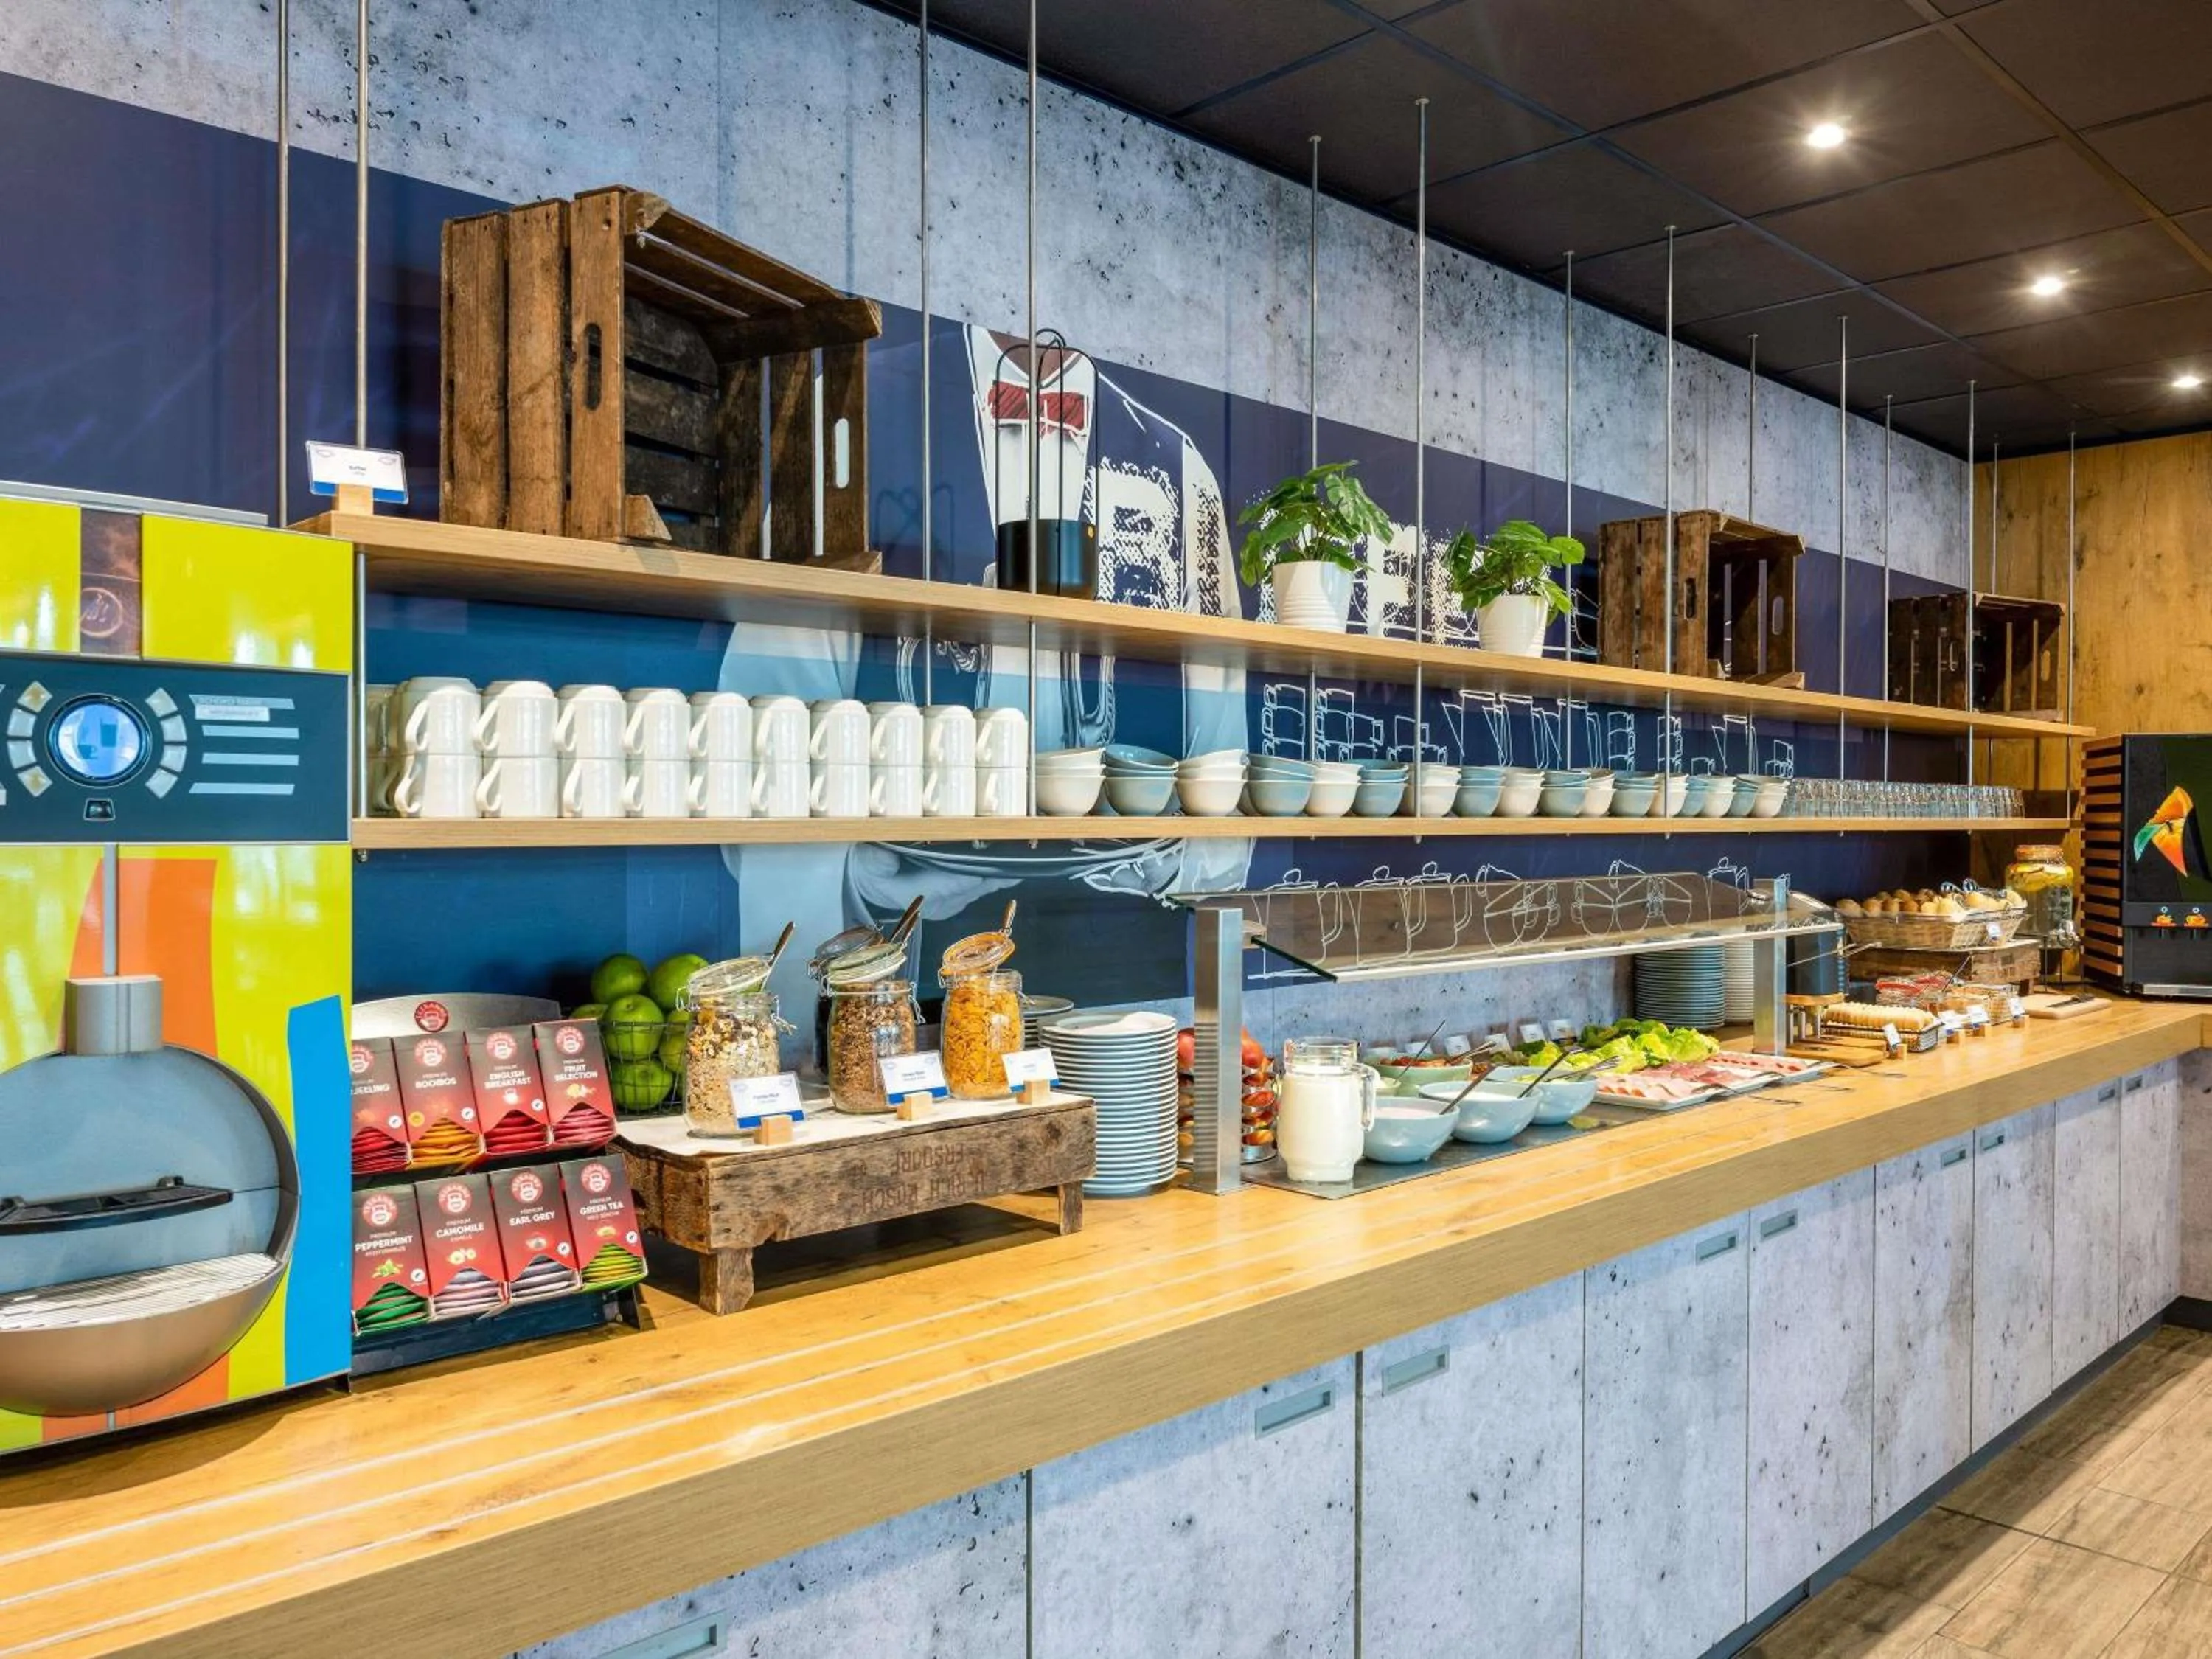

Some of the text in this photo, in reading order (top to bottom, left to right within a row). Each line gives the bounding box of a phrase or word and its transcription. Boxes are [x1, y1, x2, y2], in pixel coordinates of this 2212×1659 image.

[489, 1070, 524, 1080] ENGLISH
[564, 1064, 586, 1073] FRUIT
[415, 1077, 456, 1088] ROOIBOS
[484, 1076, 532, 1089] BREAKFAST
[554, 1071, 598, 1082] SELECTION
[351, 1082, 389, 1095] JEELING
[579, 1200, 625, 1215] GREEN TEA
[509, 1211, 555, 1226] EARL GREY
[436, 1222, 484, 1239] CAMOMILE
[355, 1235, 413, 1252] PEPPERMINT
